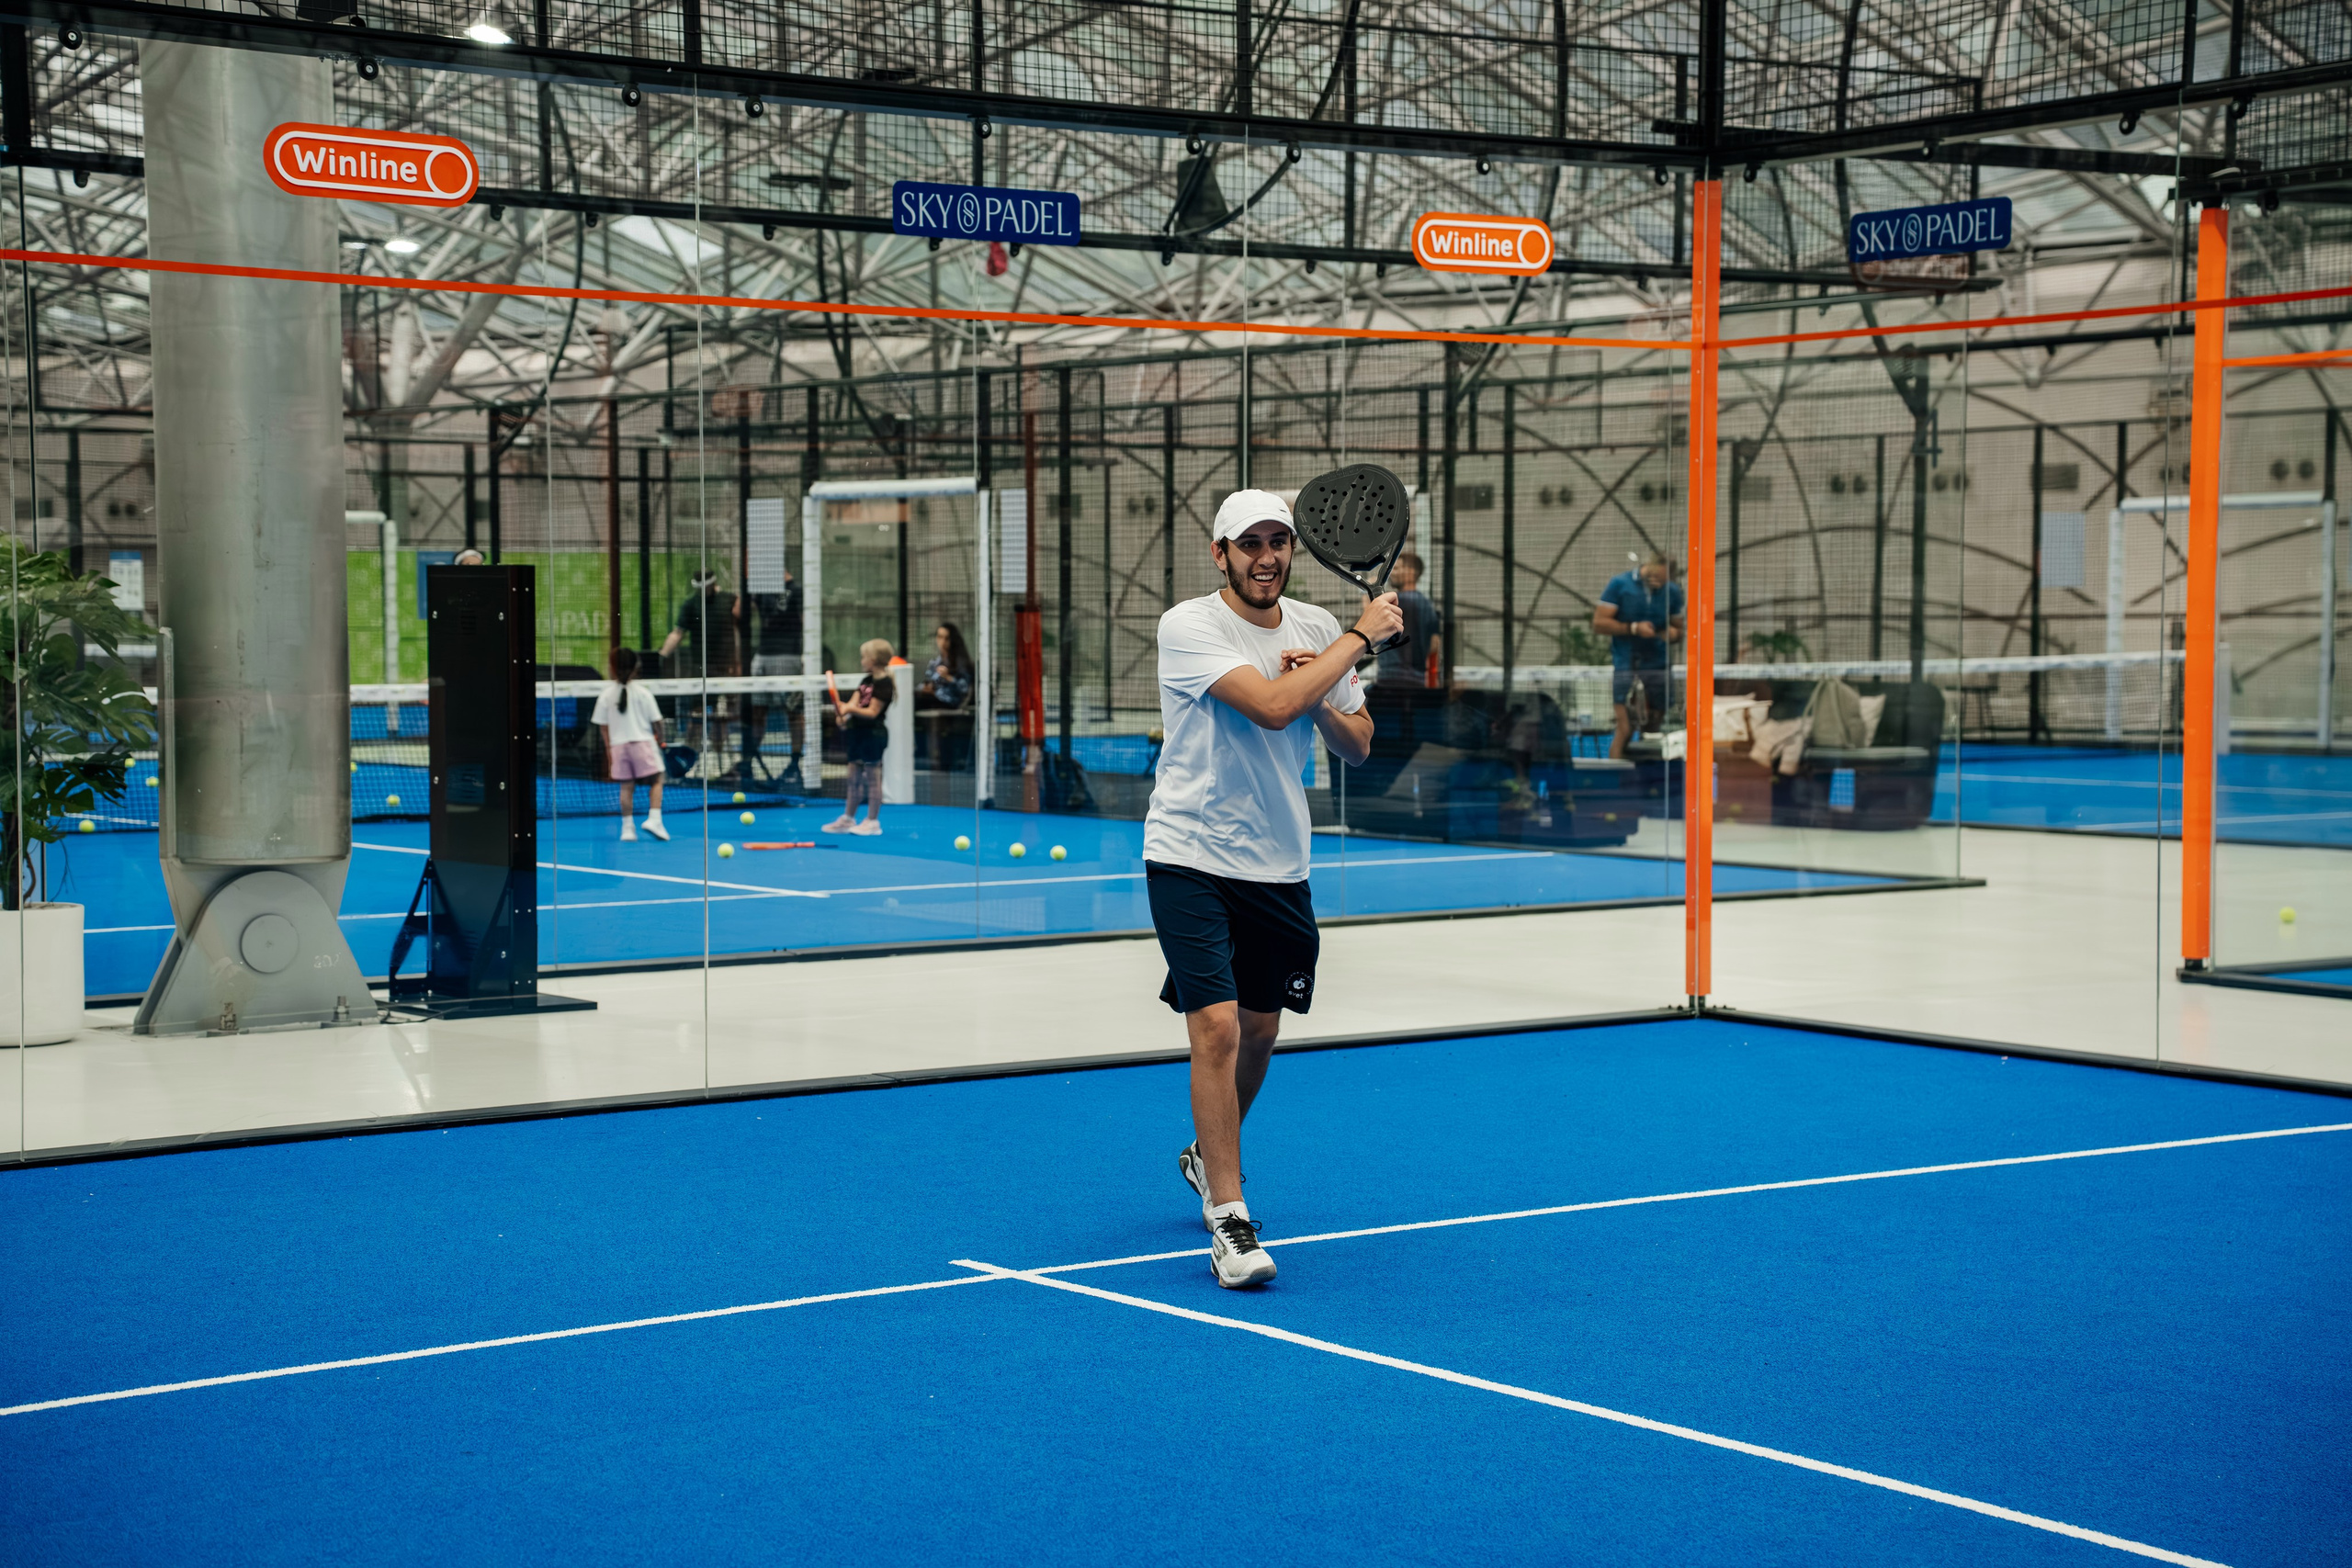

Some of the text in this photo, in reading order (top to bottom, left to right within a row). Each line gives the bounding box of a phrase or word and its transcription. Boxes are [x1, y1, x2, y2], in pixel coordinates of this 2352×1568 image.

[292, 143, 418, 183] Winline
[900, 191, 1072, 236] SKY PADEL
[1856, 207, 2004, 255] SKY PADEL
[1430, 230, 1513, 257] Winline
[560, 609, 639, 637] PADL
